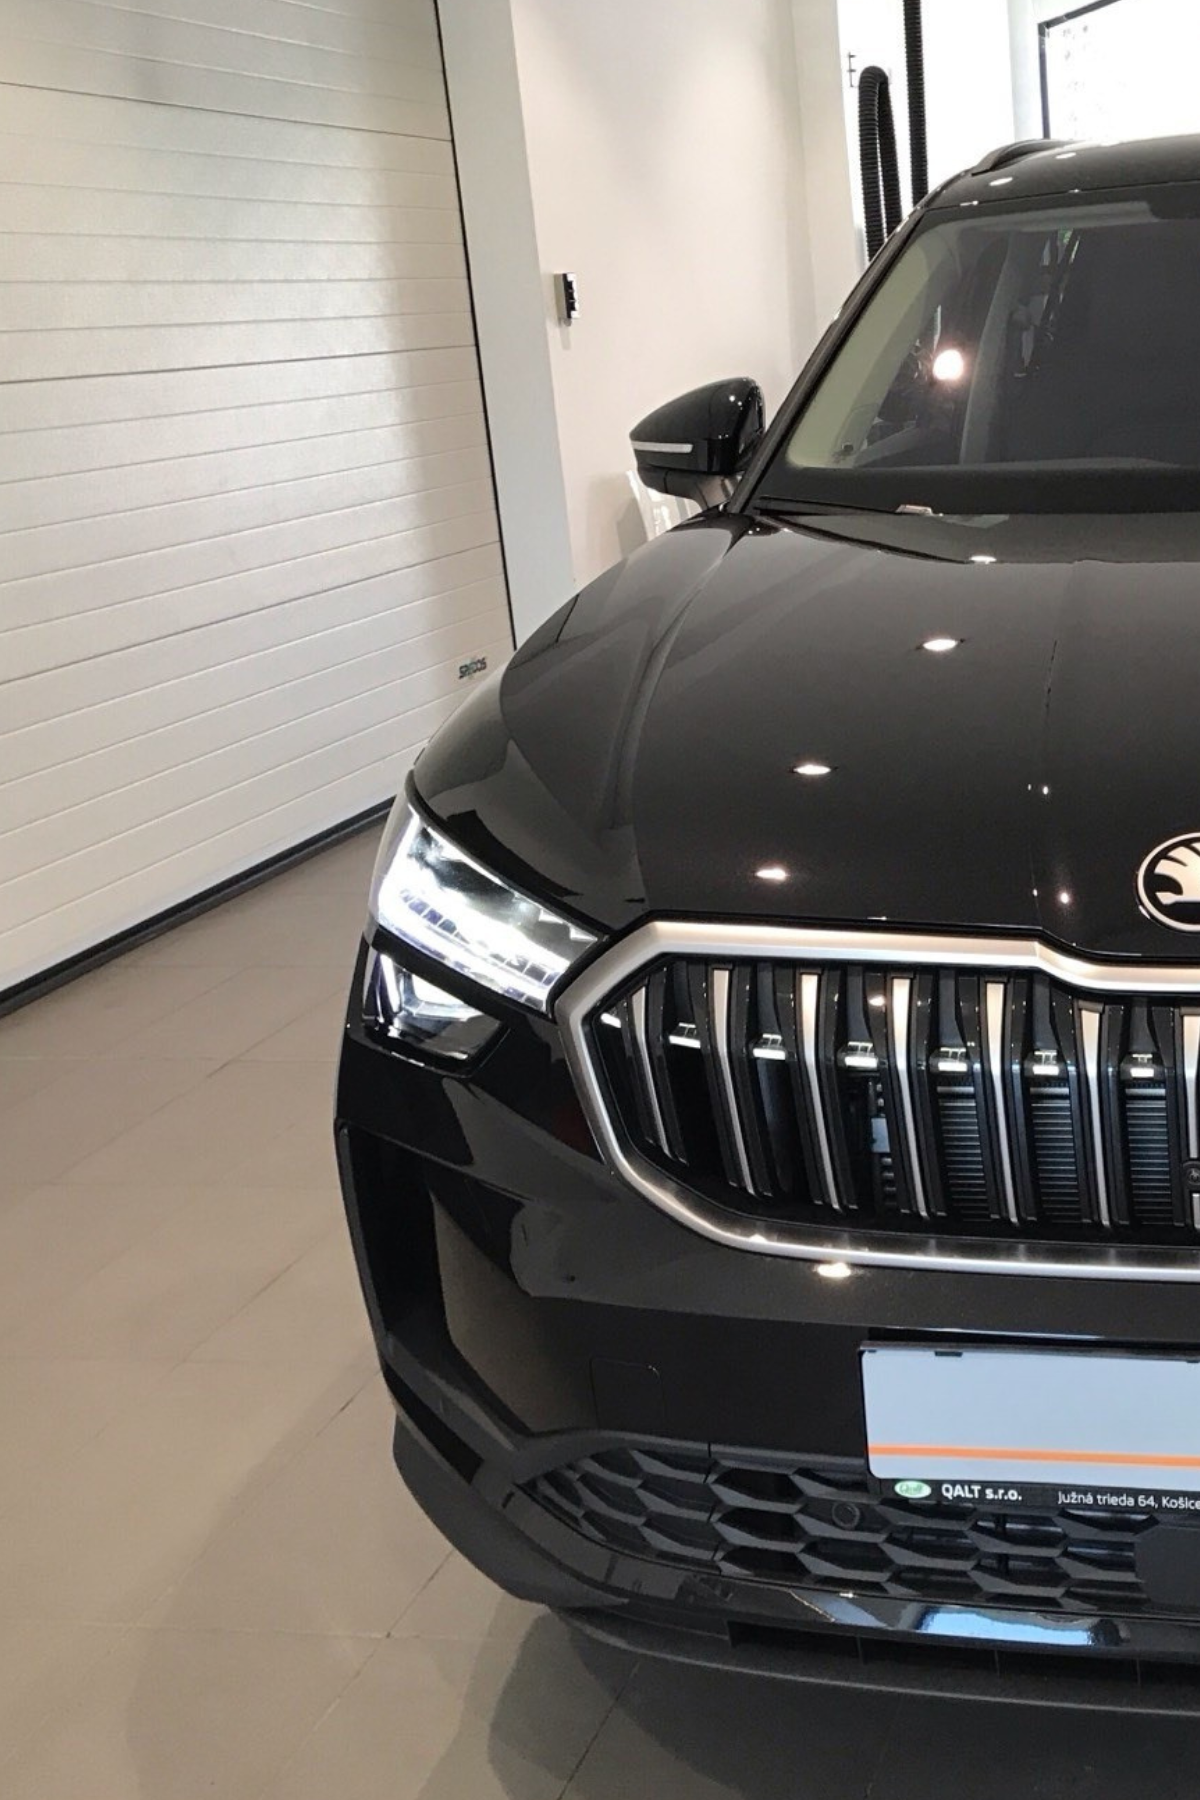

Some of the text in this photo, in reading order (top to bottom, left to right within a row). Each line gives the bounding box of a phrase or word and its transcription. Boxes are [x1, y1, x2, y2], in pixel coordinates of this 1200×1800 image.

[941, 1483, 1022, 1501] QALT s.r.o.
[1057, 1490, 1094, 1505] Južná
[1096, 1492, 1135, 1507] trieda
[1137, 1494, 1159, 1509] 64,
